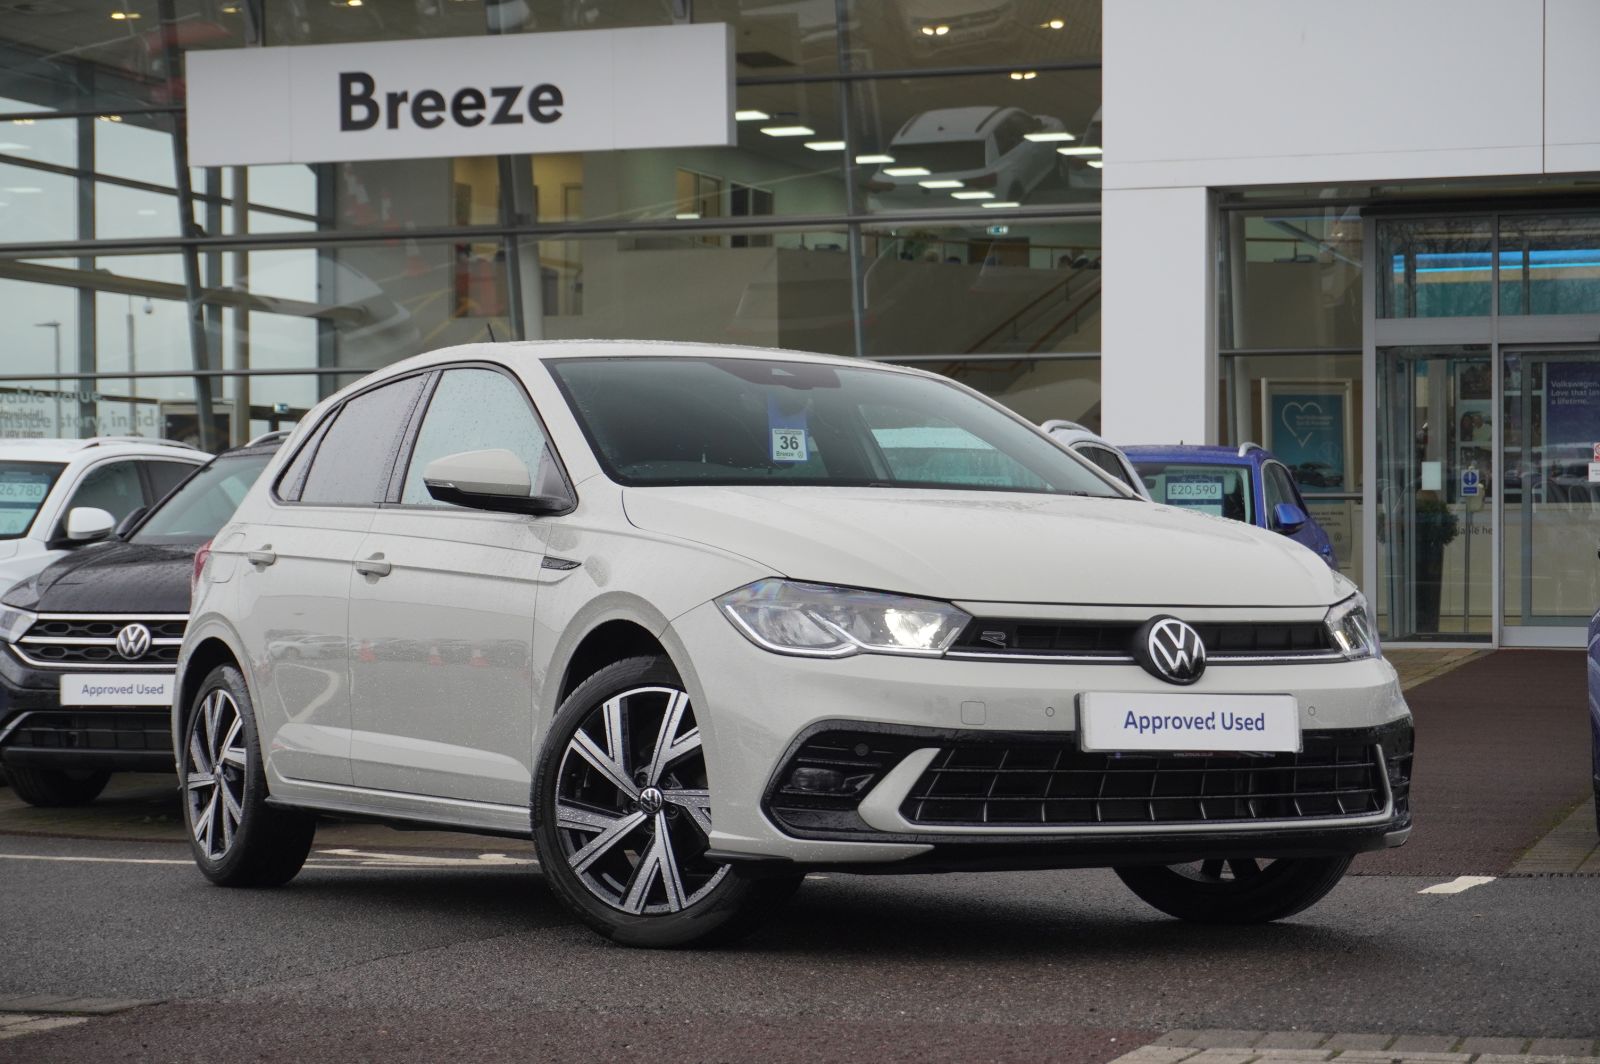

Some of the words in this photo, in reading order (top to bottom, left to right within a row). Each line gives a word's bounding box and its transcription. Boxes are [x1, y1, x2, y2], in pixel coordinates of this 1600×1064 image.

[339, 71, 564, 132] Breeze
[780, 436, 799, 450] 36
[1171, 484, 1217, 496] £20,590
[82, 684, 134, 697] Approved
[136, 684, 164, 695] Used
[1124, 710, 1216, 734] Approved
[1221, 712, 1265, 731] Used
